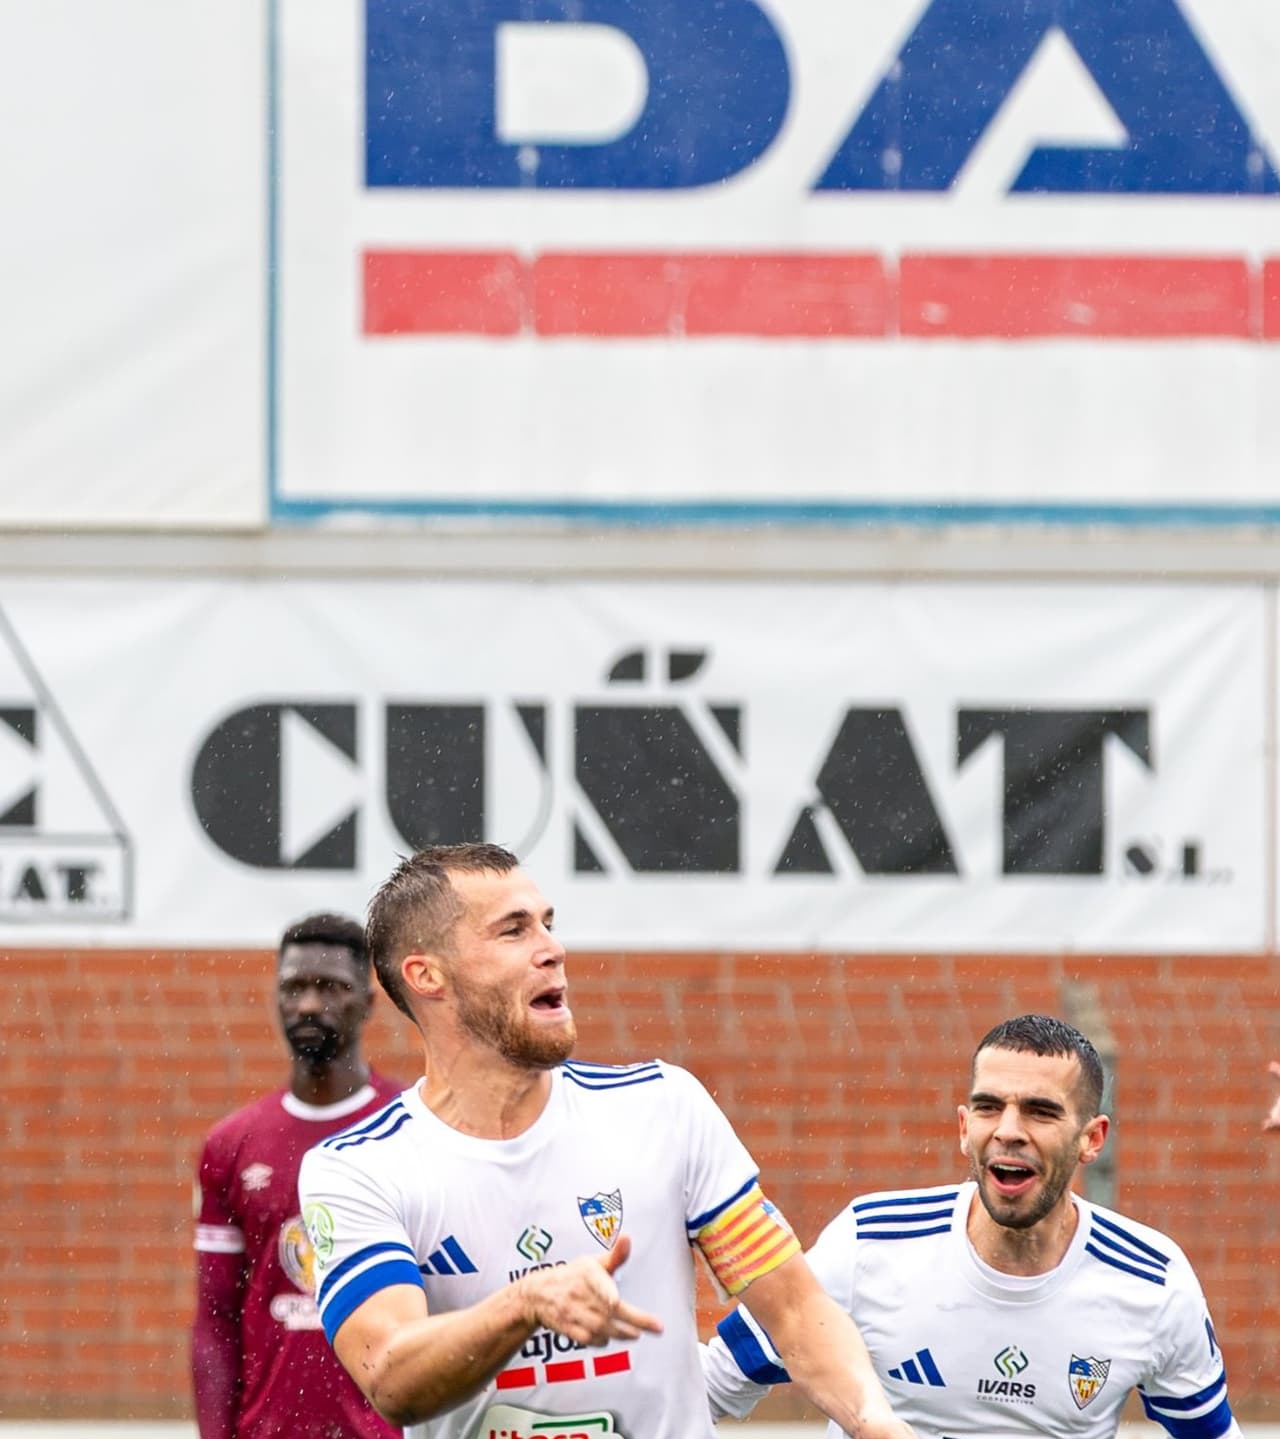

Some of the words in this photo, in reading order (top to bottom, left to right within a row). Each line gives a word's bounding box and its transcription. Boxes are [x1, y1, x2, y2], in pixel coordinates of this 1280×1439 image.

[190, 644, 1157, 877] CUÑAT
[520, 1324, 588, 1363] ujo
[977, 1378, 1037, 1399] IVARS
